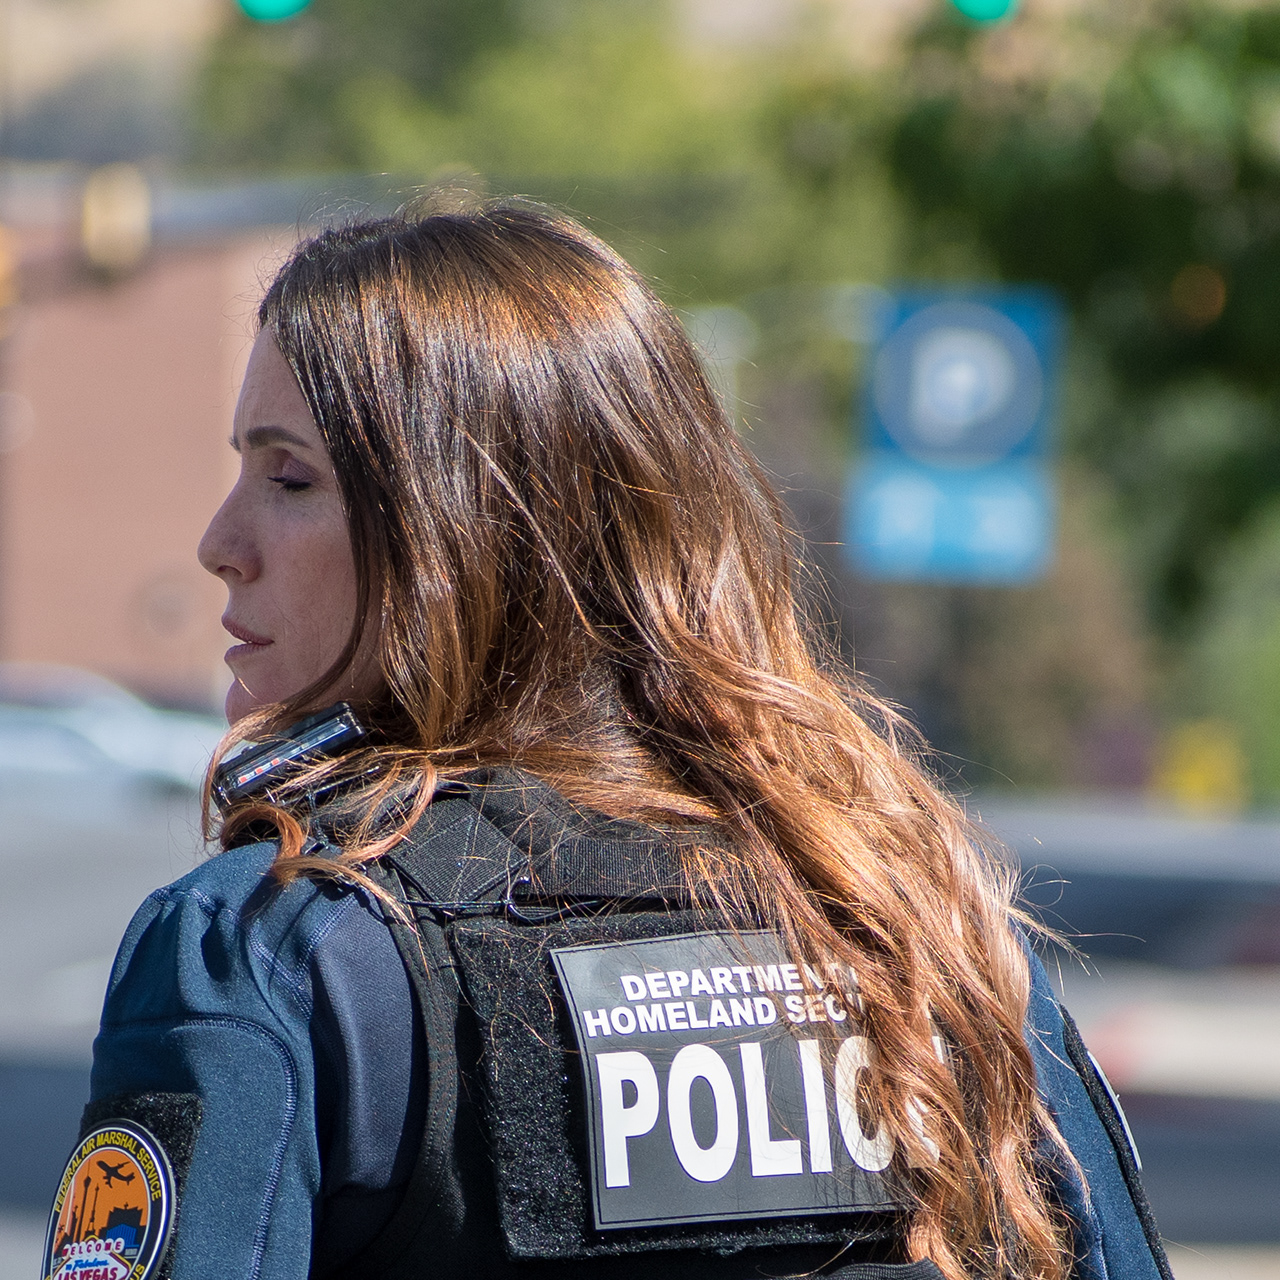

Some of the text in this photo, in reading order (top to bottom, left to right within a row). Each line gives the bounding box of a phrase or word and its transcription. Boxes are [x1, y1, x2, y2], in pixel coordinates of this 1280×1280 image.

[582, 993, 866, 1038] HOMELAND SEC
[55, 1131, 162, 1212] FEDERAL AIR MARSHAL SERVICE
[62, 1241, 122, 1257] WELCOME
